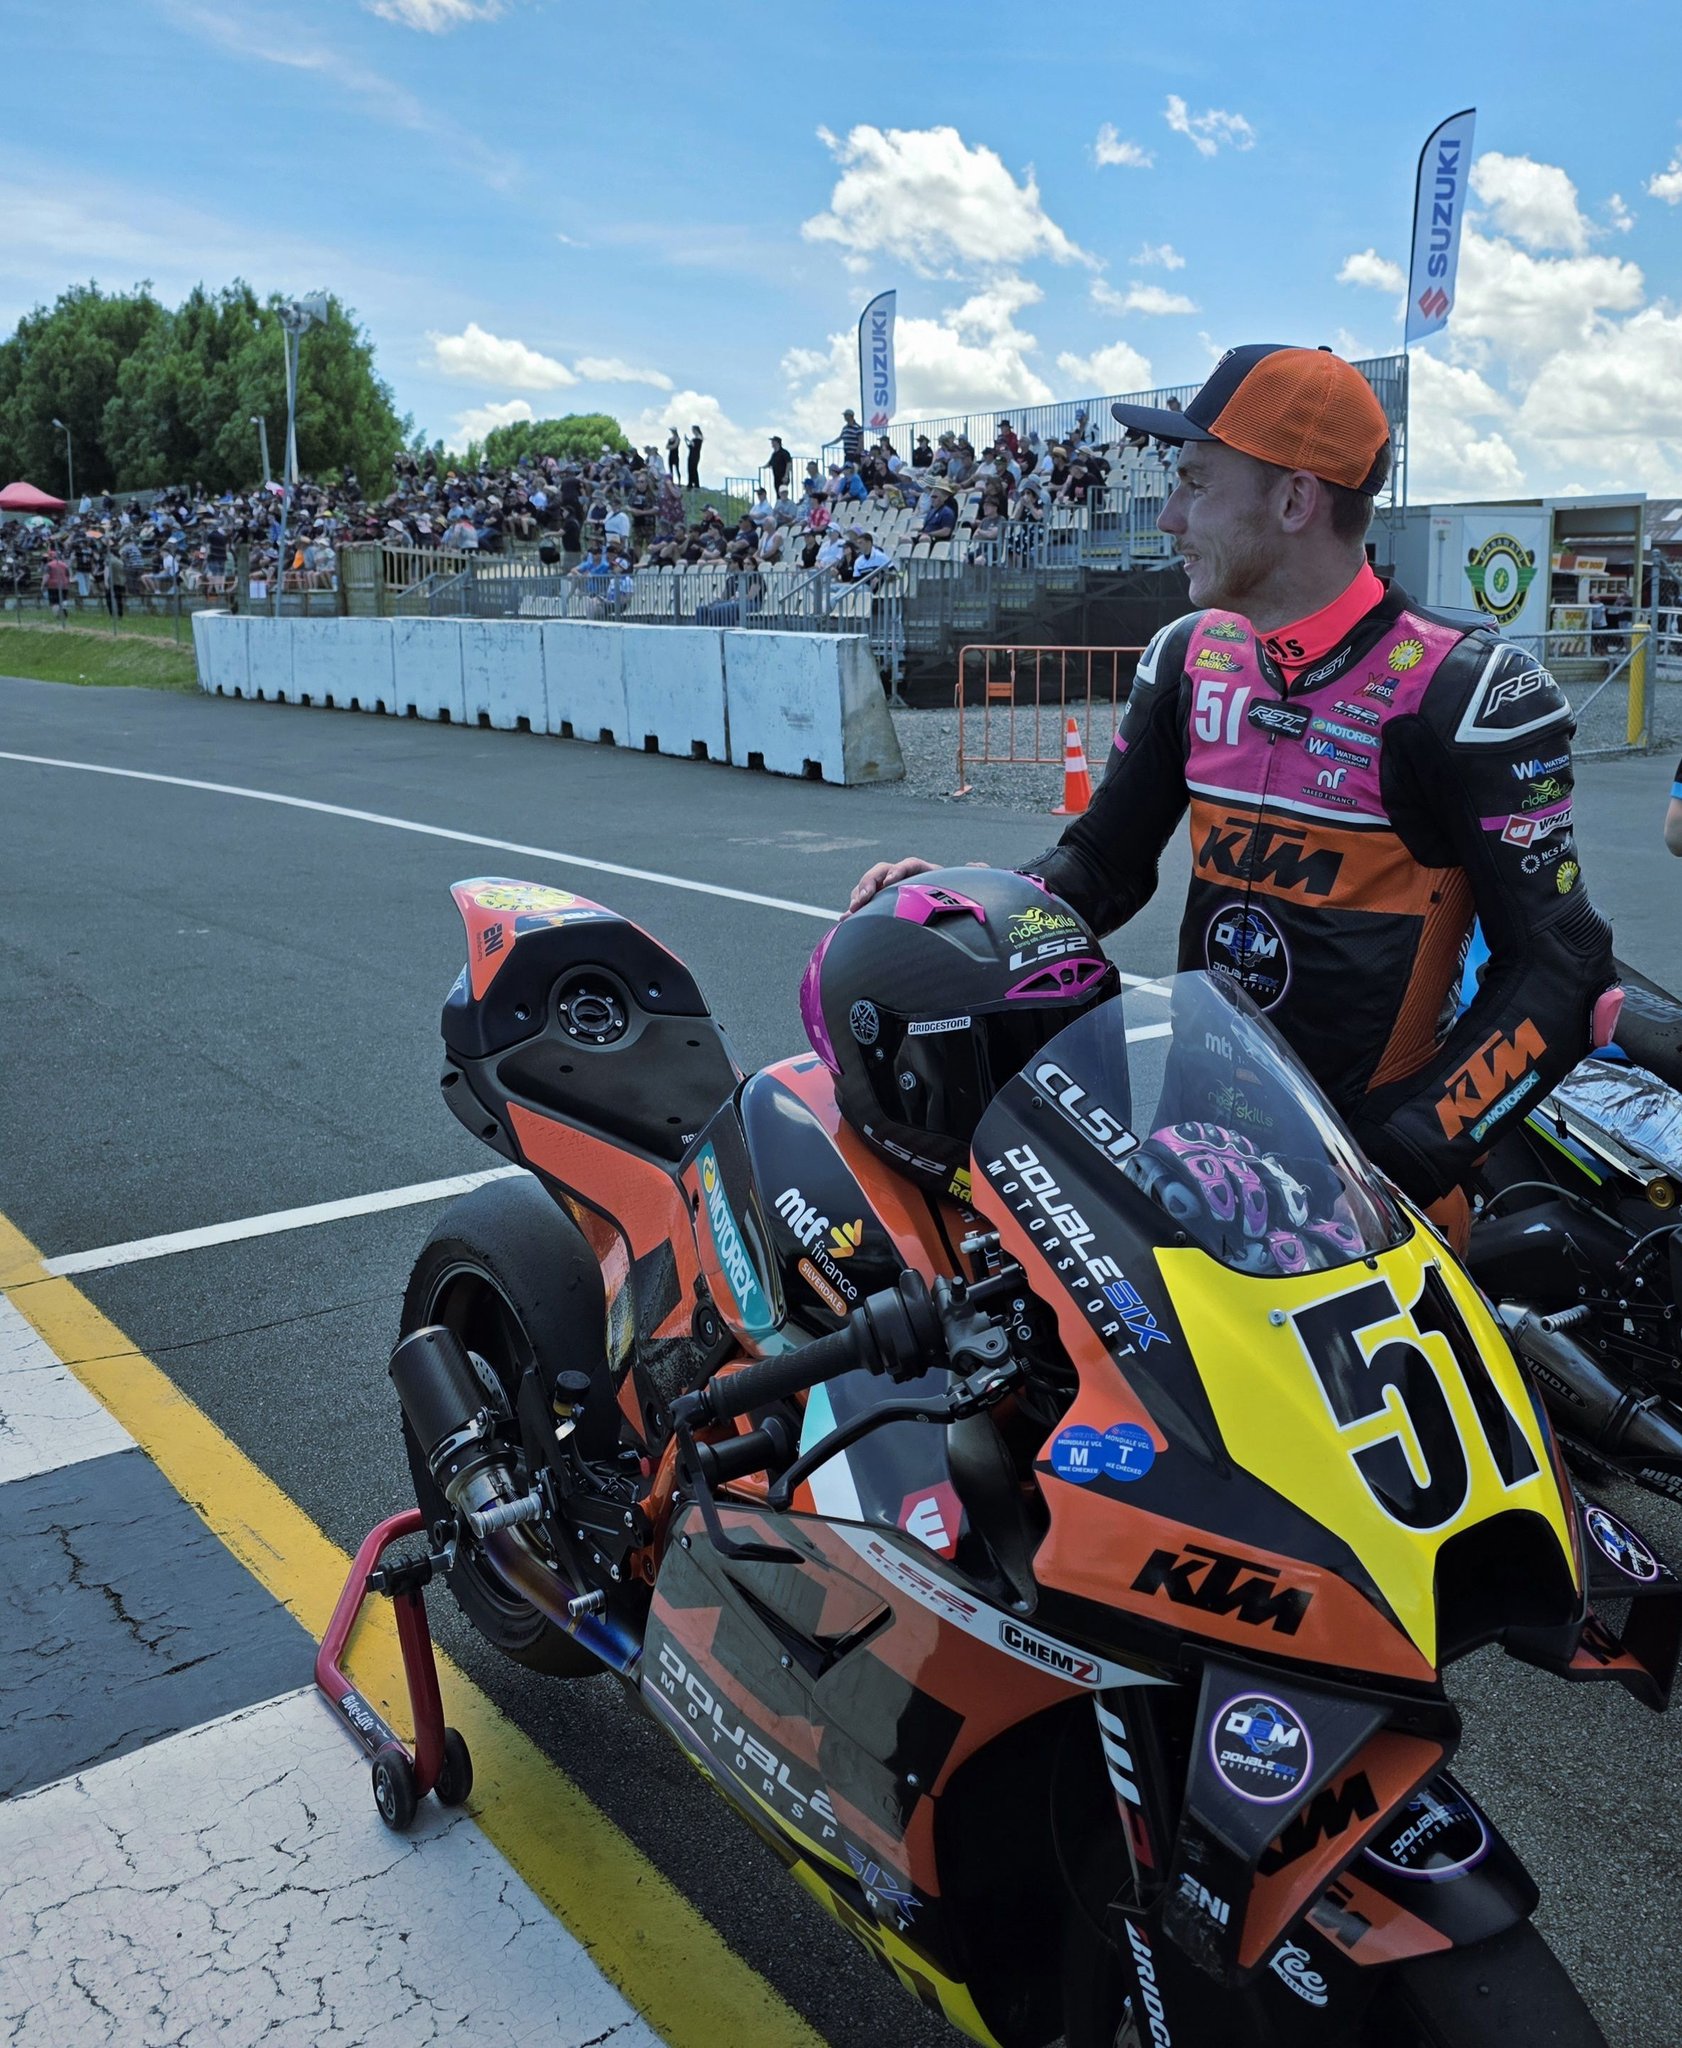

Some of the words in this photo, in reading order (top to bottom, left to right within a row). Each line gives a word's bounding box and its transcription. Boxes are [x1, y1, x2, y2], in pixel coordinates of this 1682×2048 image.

[1428, 140, 1461, 278] SUZUKI
[871, 310, 888, 407] SUZUKI
[1304, 645, 1351, 687] RST
[1195, 680, 1251, 746] 51
[1248, 705, 1307, 727] RST
[1334, 700, 1380, 720] LS2
[1483, 669, 1562, 719] RST
[1325, 722, 1377, 746] MOTOREX
[1335, 749, 1369, 764] WATSON
[1302, 787, 1323, 799] NAKED
[1324, 792, 1357, 806] FINANCE
[1540, 809, 1572, 831] WHIT
[1200, 817, 1345, 897] KTM
[1541, 846, 1559, 860] NCS
[1009, 936, 1090, 972] LS2
[909, 1017, 969, 1033] BRIDGESTONE
[1435, 1017, 1547, 1141] KTM
[1486, 1072, 1538, 1126] MOTOREX
[1036, 1063, 1138, 1157] CL51
[864, 1124, 947, 1175] LS2
[774, 1187, 830, 1247] mtf
[709, 1179, 757, 1312] MOTOREX
[811, 1239, 858, 1301] finance
[986, 1160, 1136, 1358] MOTORSPORT
[801, 1262, 843, 1313] SILVERDALE
[1288, 1262, 1542, 1534] 51
[1058, 1439, 1090, 1447] MONDIALE
[1069, 1447, 1089, 1466] M
[1105, 1434, 1137, 1446] MONDIALE
[1119, 1445, 1134, 1464] T
[1072, 1466, 1099, 1474] CHECKED
[1116, 1464, 1142, 1475] CHECKED
[868, 1541, 978, 1614] LS2
[1130, 1543, 1314, 1636] KTM
[660, 1671, 910, 1931] MOTORSPRT
[1124, 1918, 1171, 2048] BRIDG
[1281, 1972, 1315, 2001] DESIGN
